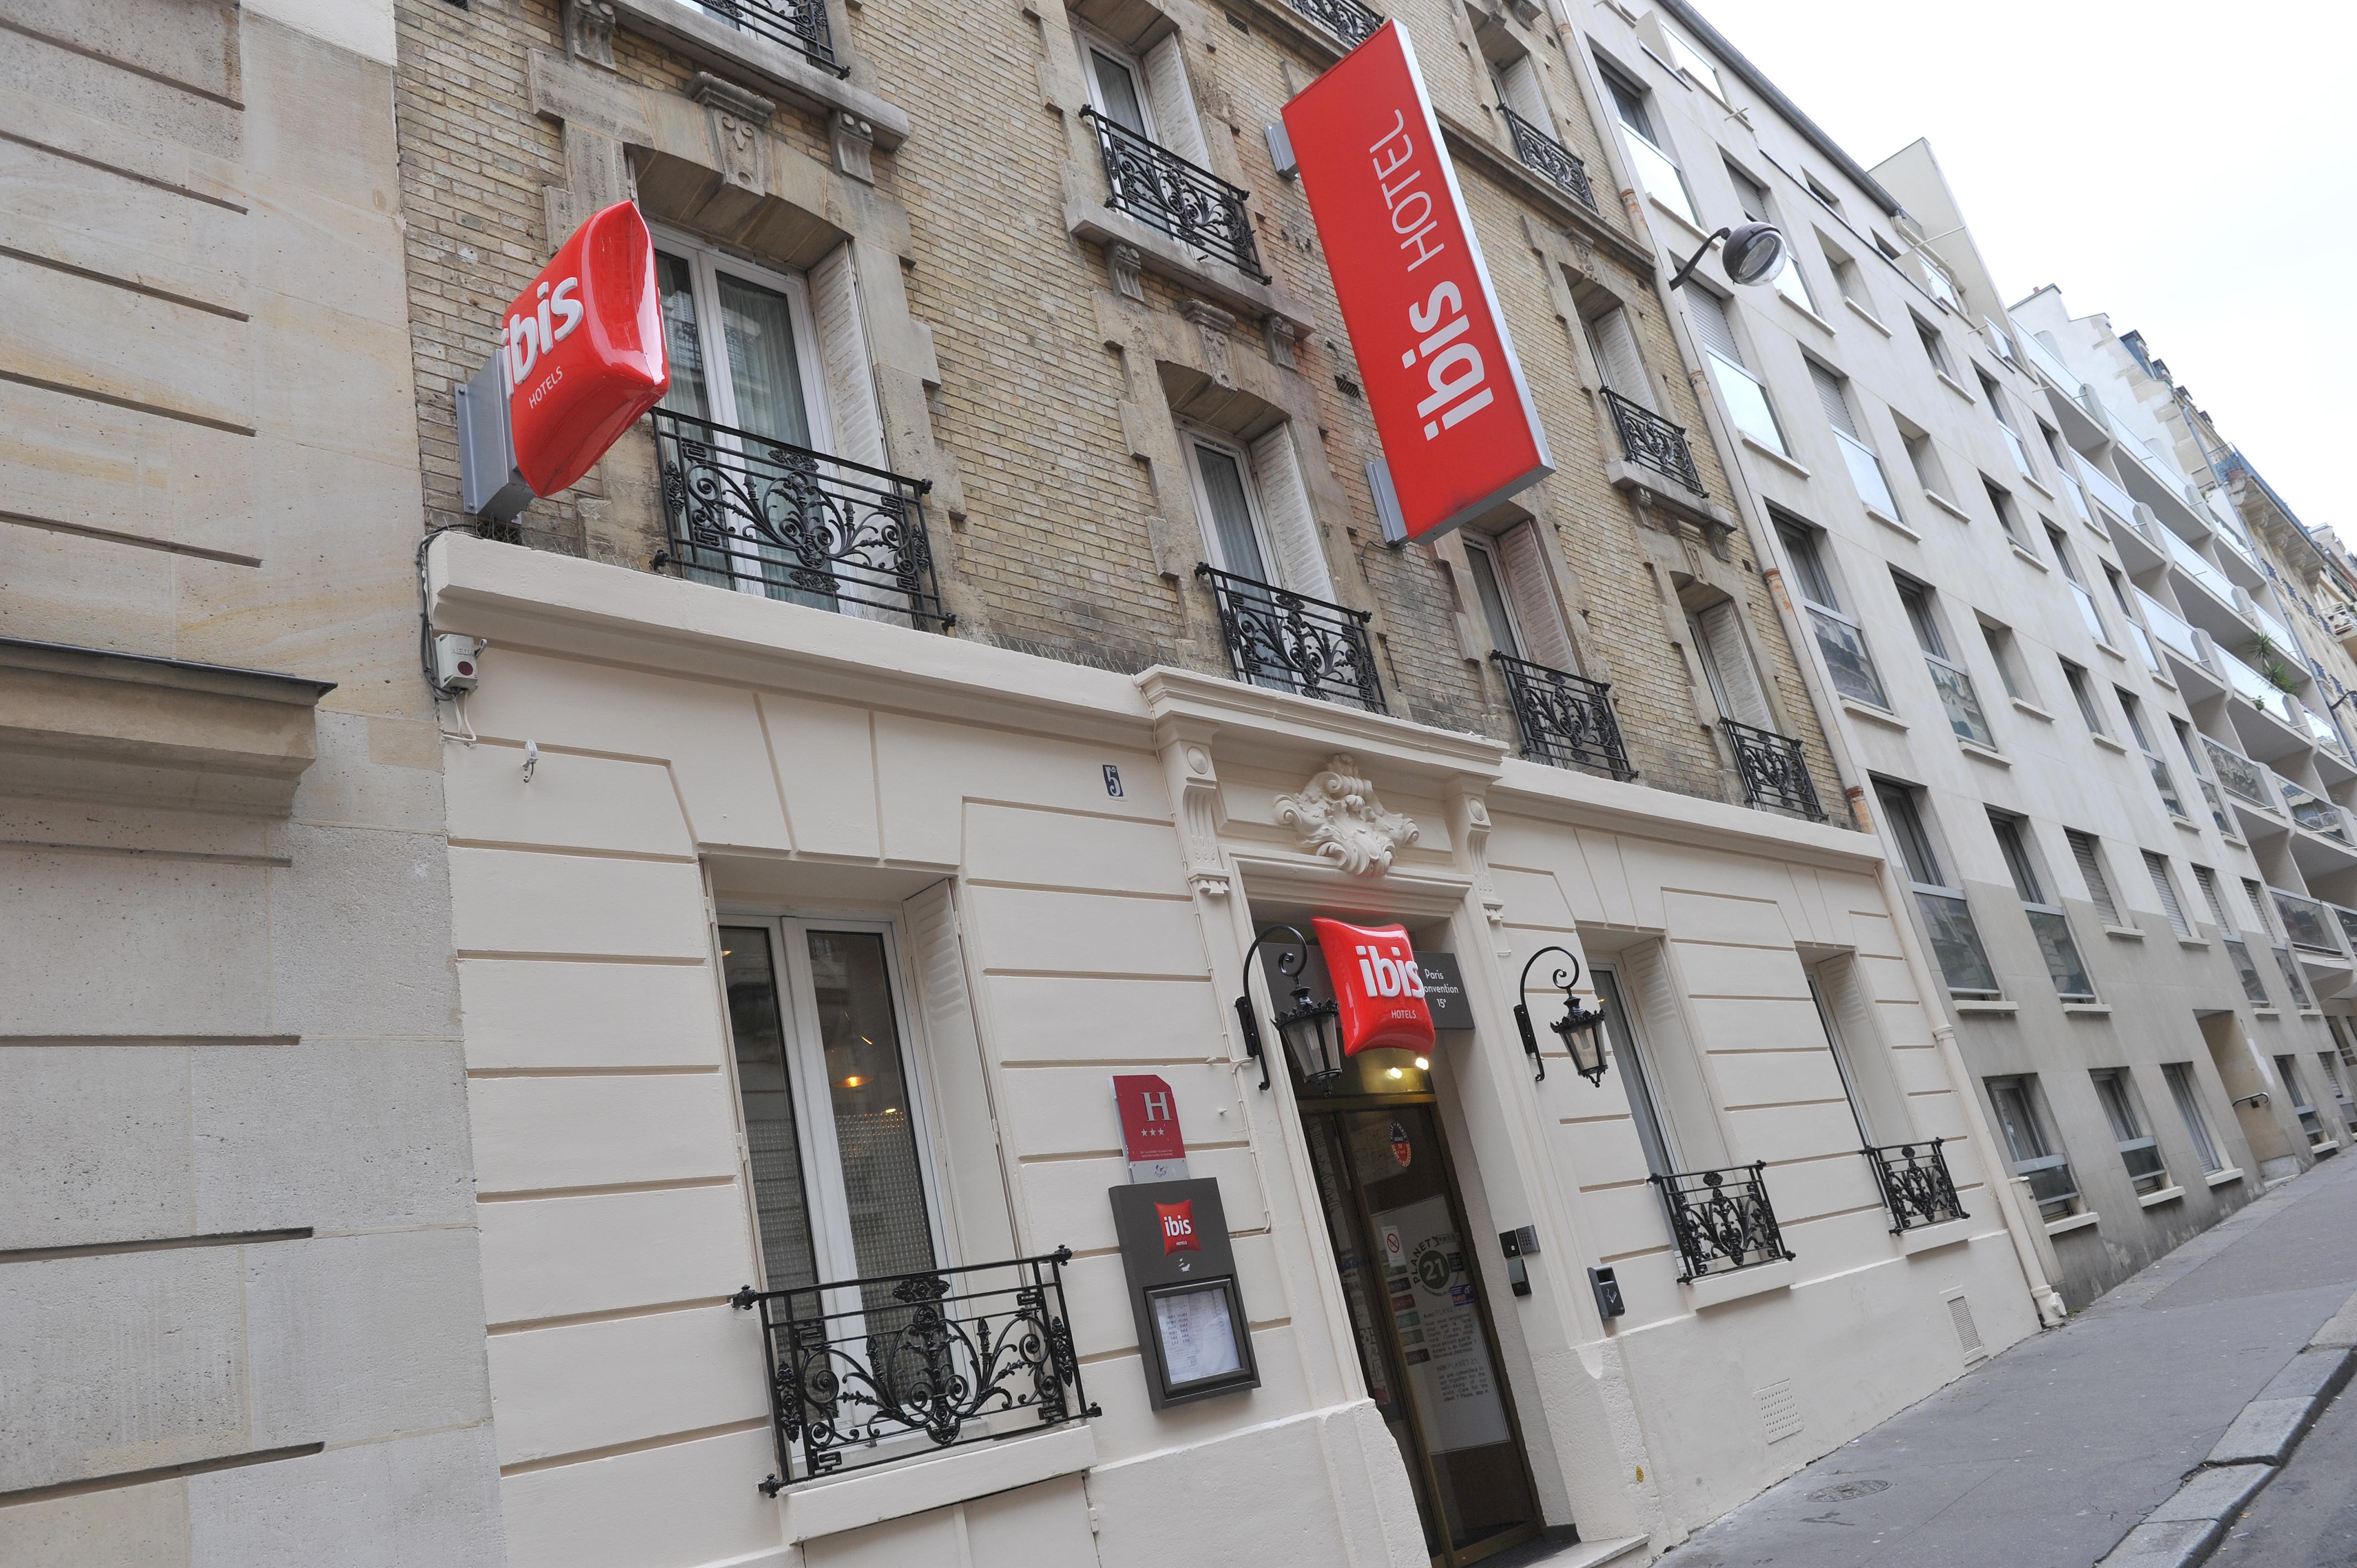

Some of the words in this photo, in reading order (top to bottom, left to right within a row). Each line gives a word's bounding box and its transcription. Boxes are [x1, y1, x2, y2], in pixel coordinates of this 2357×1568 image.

[1369, 109, 1444, 272] HOTEL
[501, 277, 583, 399] ibis
[1402, 280, 1494, 441] ibis
[528, 365, 563, 409] HOTELS
[451, 647, 475, 657] NEON
[1105, 766, 1121, 796] 5
[1355, 945, 1425, 999] ibis
[1424, 968, 1444, 979] Paris
[1423, 983, 1459, 994] onvention
[1391, 1009, 1417, 1019] HOTELS
[1140, 1091, 1173, 1121] H
[1164, 1215, 1192, 1236] ibis
[1410, 1239, 1432, 1284] PLANET
[1423, 1257, 1445, 1281] 21
[1390, 1282, 1407, 1291] BONE
[1393, 1299, 1413, 1309] VATION
[1447, 1358, 1469, 1369] PLANET
